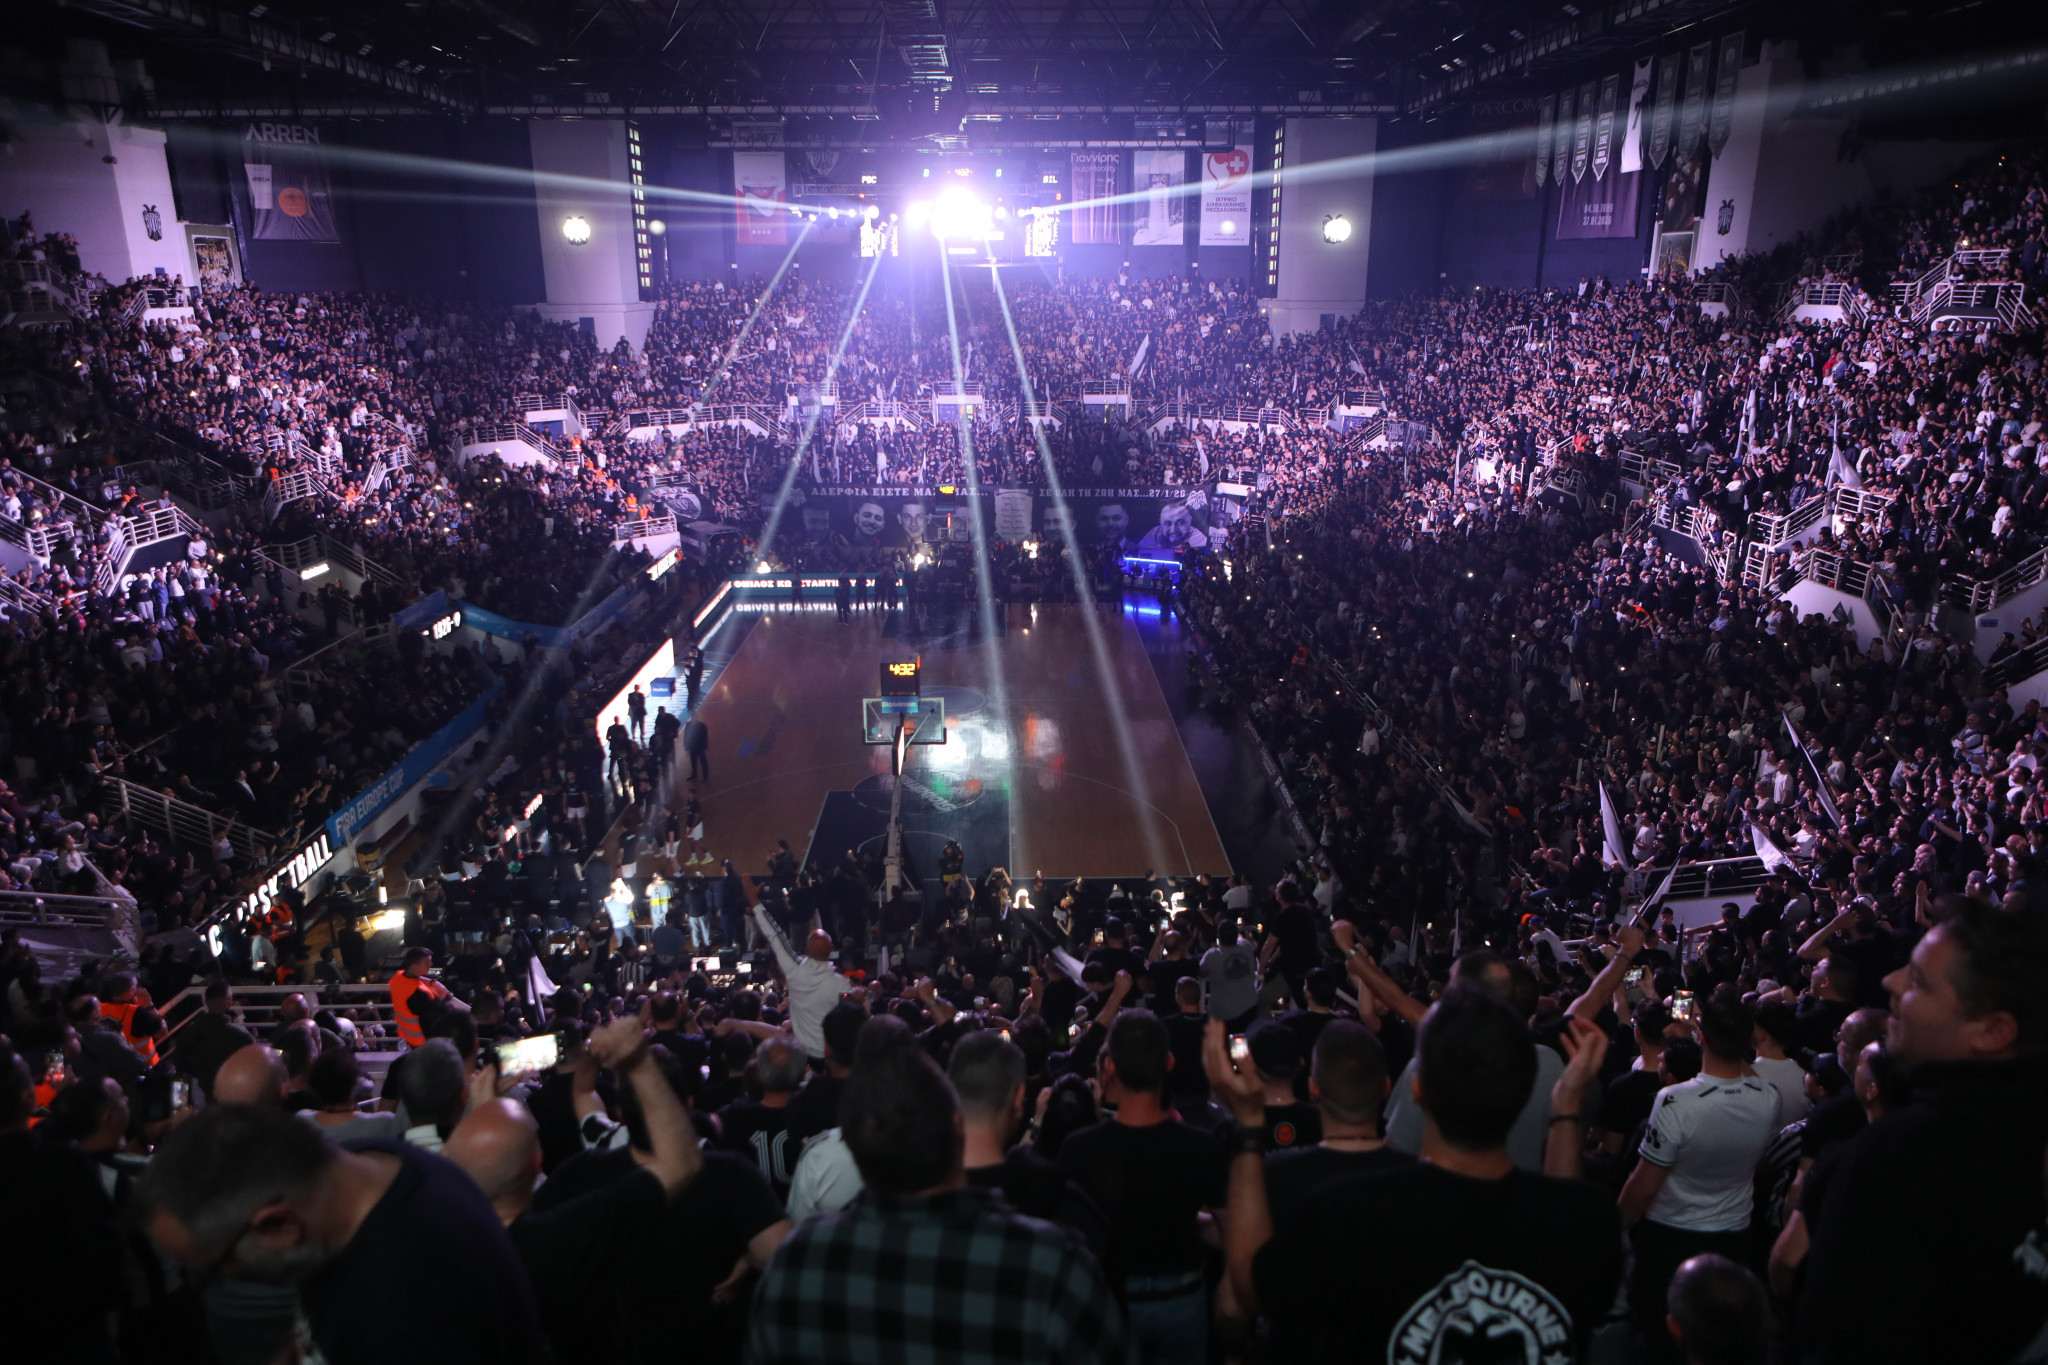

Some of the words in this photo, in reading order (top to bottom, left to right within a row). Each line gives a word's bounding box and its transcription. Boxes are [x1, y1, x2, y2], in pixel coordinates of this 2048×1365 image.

[811, 487, 868, 497] ΑΔΕΡΦΙΑ
[872, 487, 911, 497] ΕΙΣΤΕ
[1039, 488, 1052, 497] ΣΕ
[1078, 488, 1092, 497] ΤΗ
[1094, 489, 1114, 498] ΖΩΗ
[356, 780, 390, 821] EUROPE
[389, 768, 404, 794] CUP
[237, 835, 333, 936] ASKTBALL
[1400, 1270, 1569, 1358] MELBOURNE
